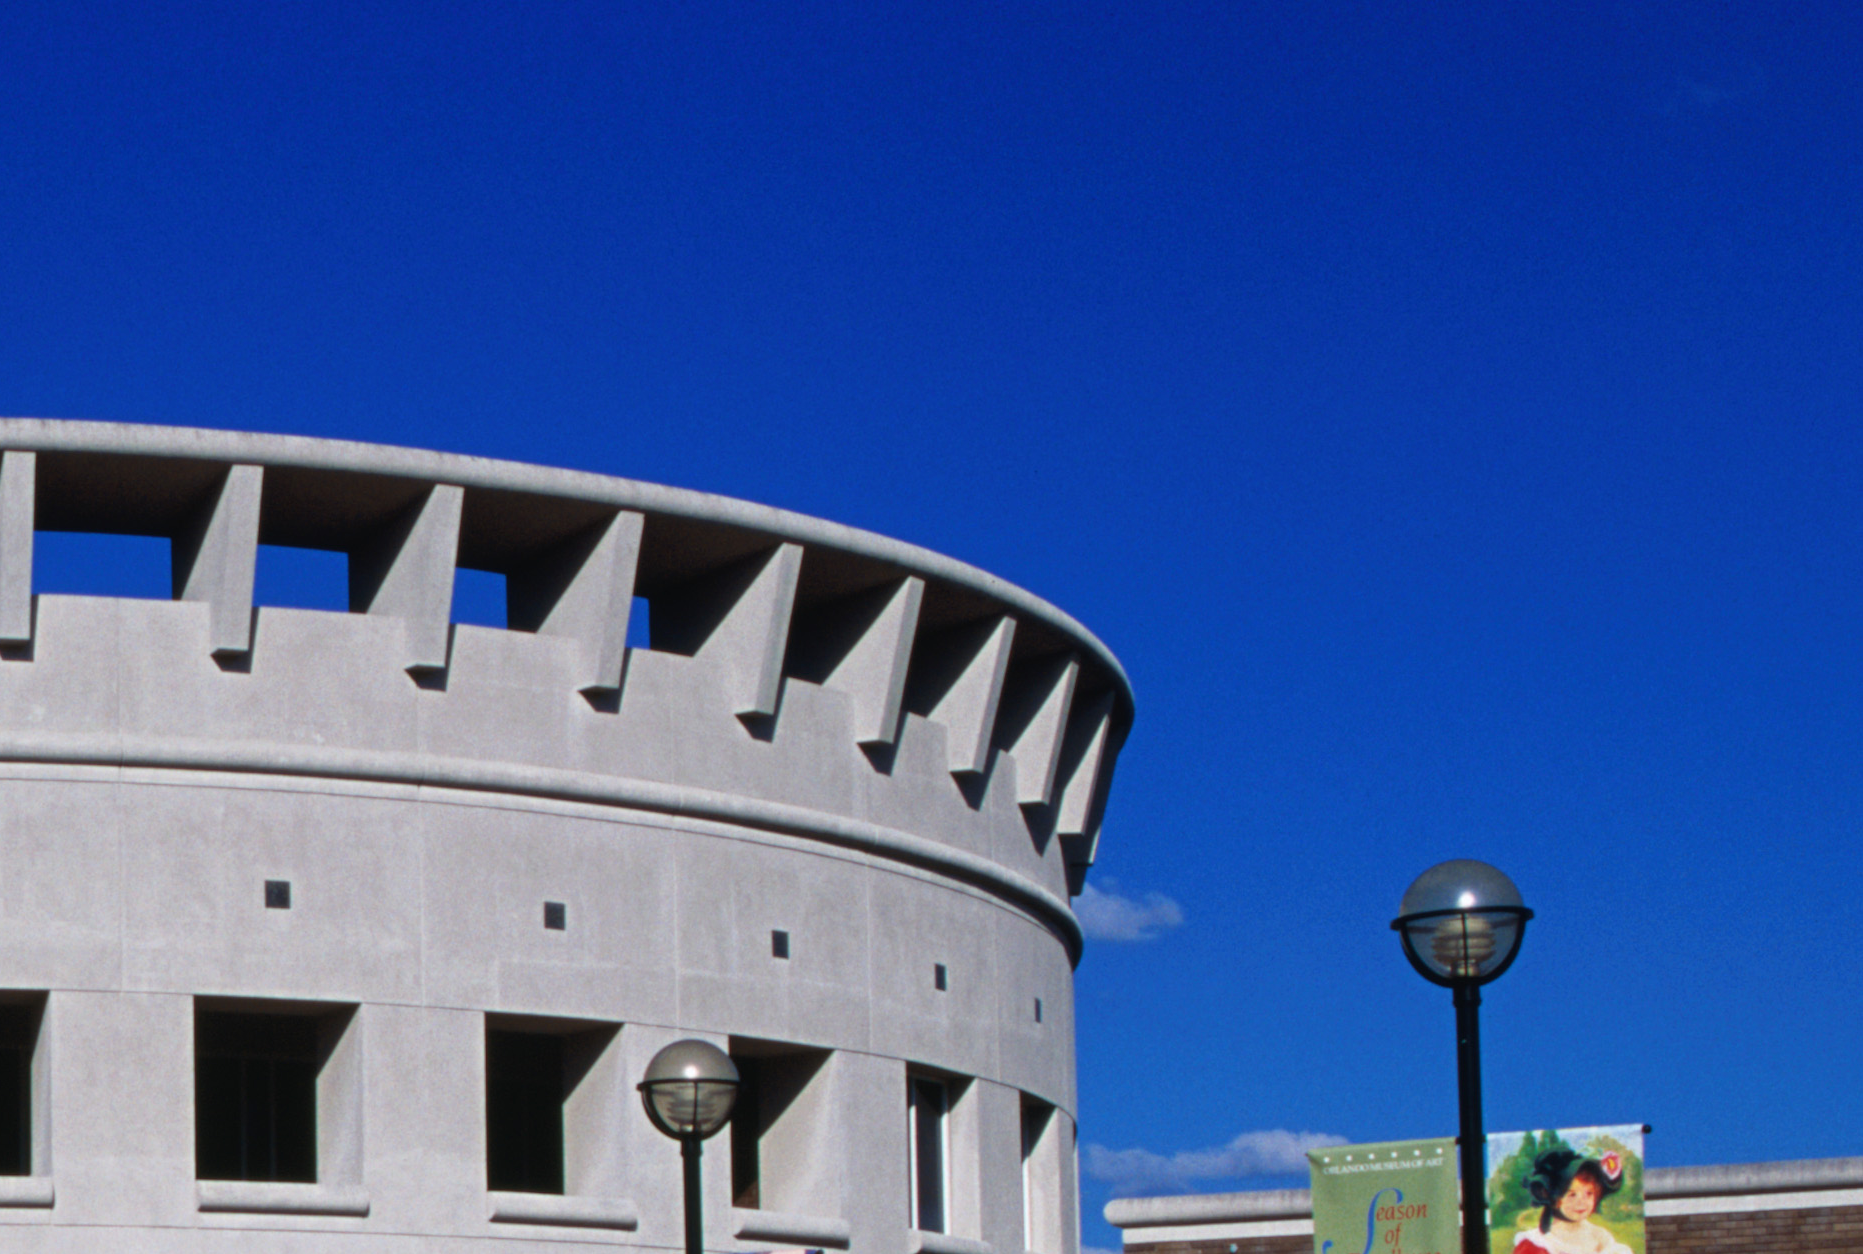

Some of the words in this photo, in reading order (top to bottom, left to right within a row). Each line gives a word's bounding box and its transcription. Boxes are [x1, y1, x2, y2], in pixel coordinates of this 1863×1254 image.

[1323, 1164, 1369, 1174] ORLANDO
[1370, 1160, 1411, 1171] MUSEUM
[1411, 1159, 1424, 1168] OF
[1426, 1157, 1444, 1167] ART
[1384, 1222, 1402, 1247] of
